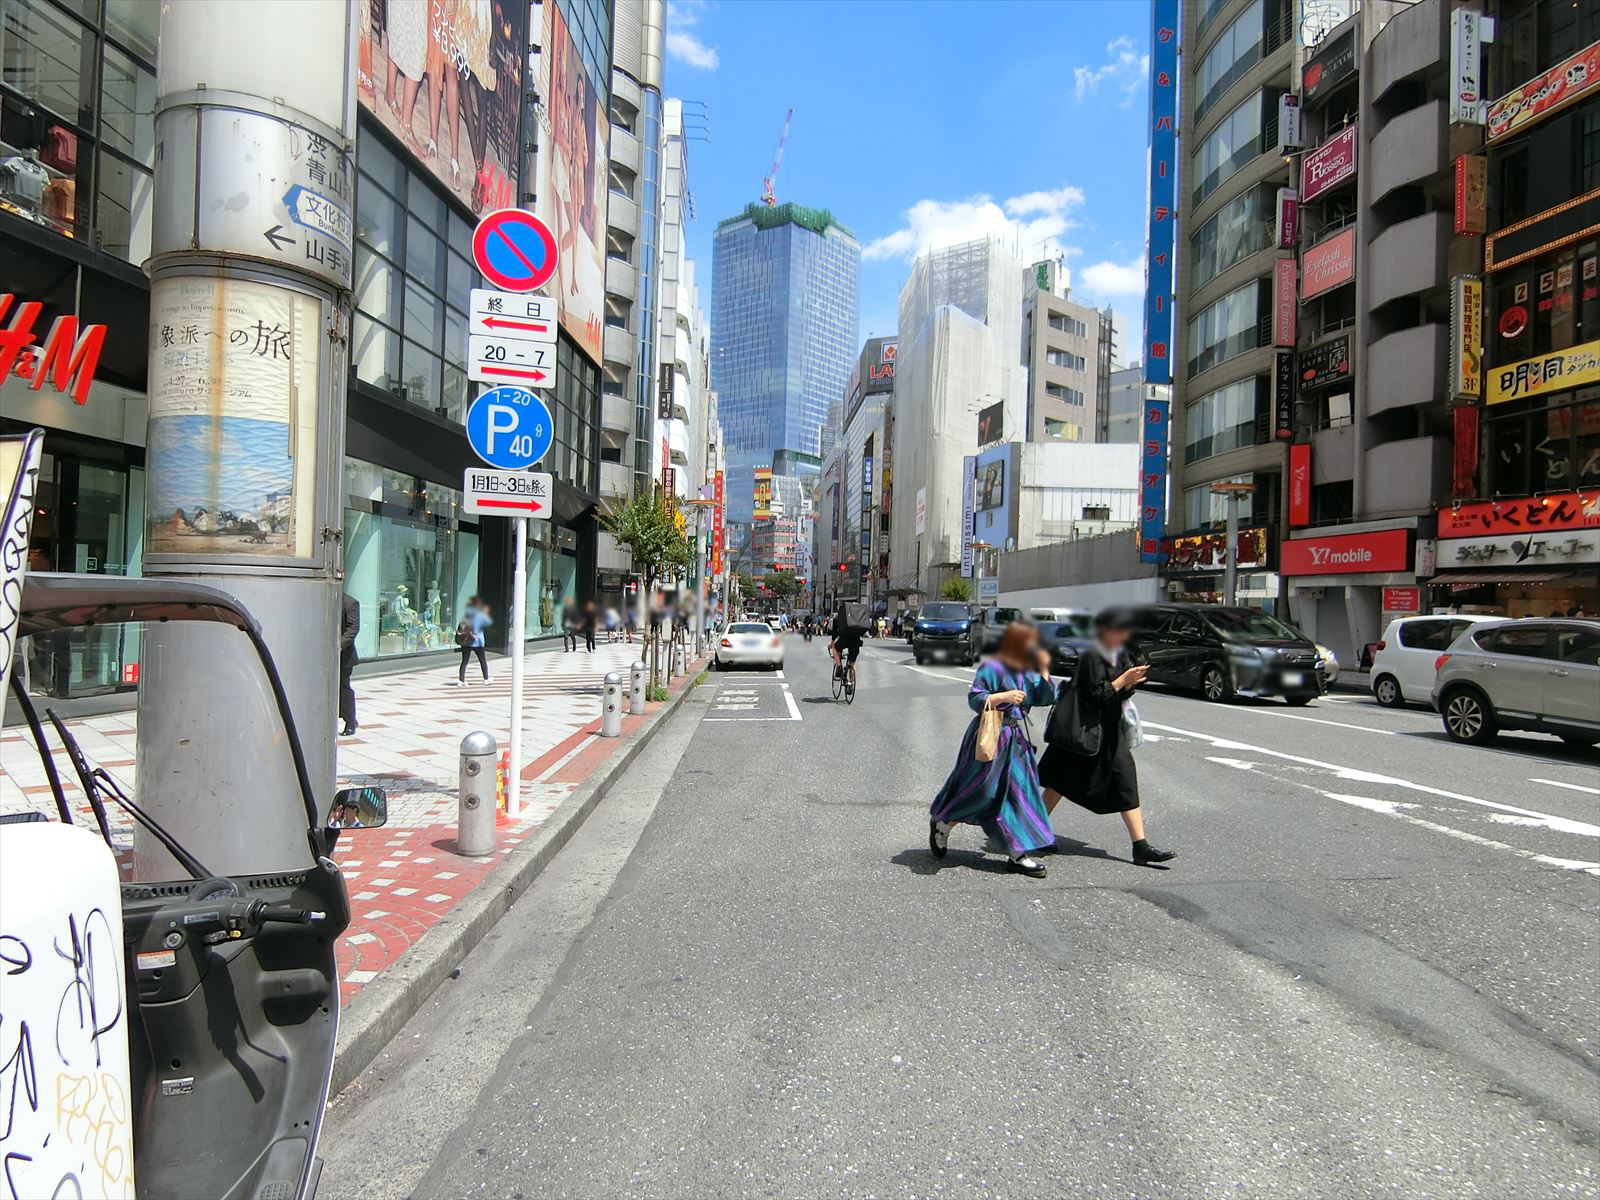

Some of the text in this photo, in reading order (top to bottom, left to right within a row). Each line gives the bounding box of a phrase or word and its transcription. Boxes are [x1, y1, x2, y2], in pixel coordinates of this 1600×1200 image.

[1461, 106, 1476, 119] 5F
[1342, 130, 1353, 144] 5F
[1305, 244, 1341, 275] Eyelash
[1314, 256, 1351, 283] Chrissie
[868, 362, 895, 379] LA
[1500, 355, 1565, 398] 明洞
[1463, 378, 1478, 391] 3F
[486, 404, 519, 455] P
[509, 434, 533, 458] 40
[1481, 500, 1577, 529] いくどん
[963, 505, 973, 573] intimissimi
[1307, 545, 1372, 566] Y!mobile
